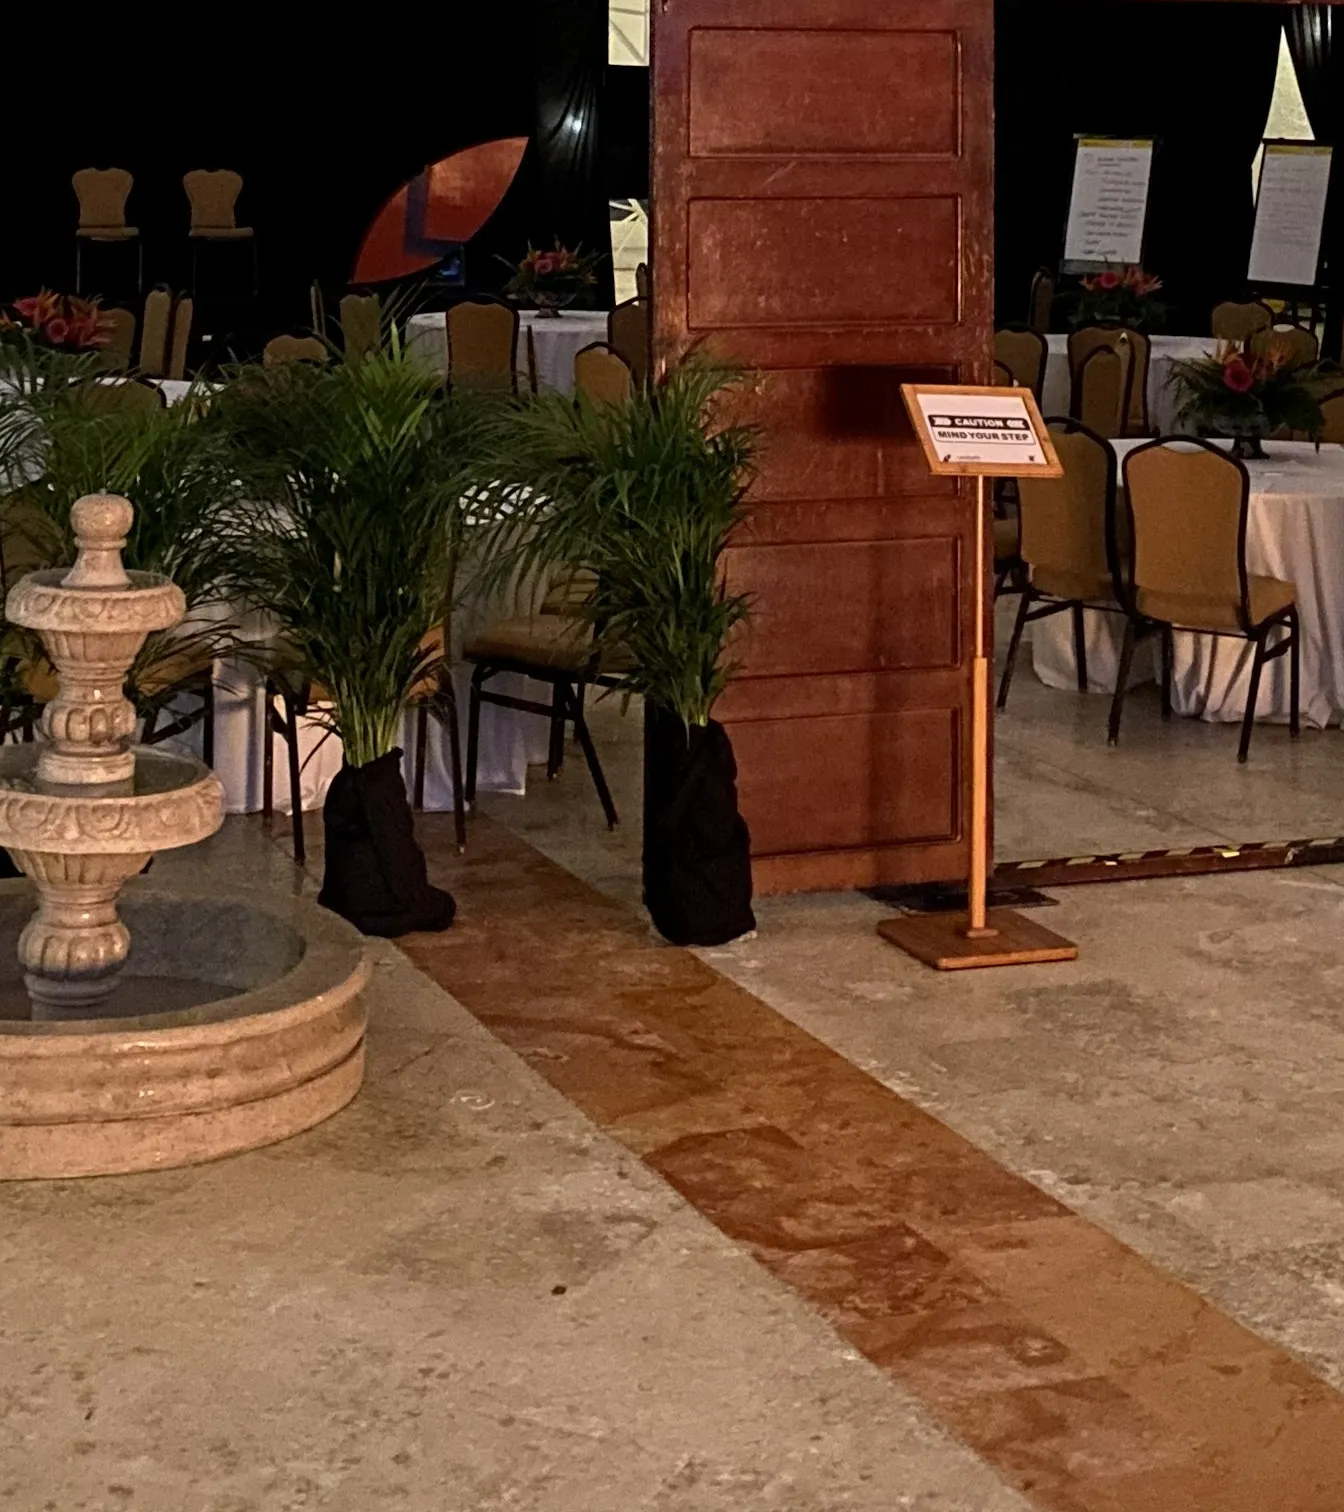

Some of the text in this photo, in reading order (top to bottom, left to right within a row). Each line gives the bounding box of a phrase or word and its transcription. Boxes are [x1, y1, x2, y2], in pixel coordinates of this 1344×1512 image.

[954, 419, 1004, 427] CAUTION
[938, 431, 967, 439] MIND
[969, 432, 998, 440] YOUR
